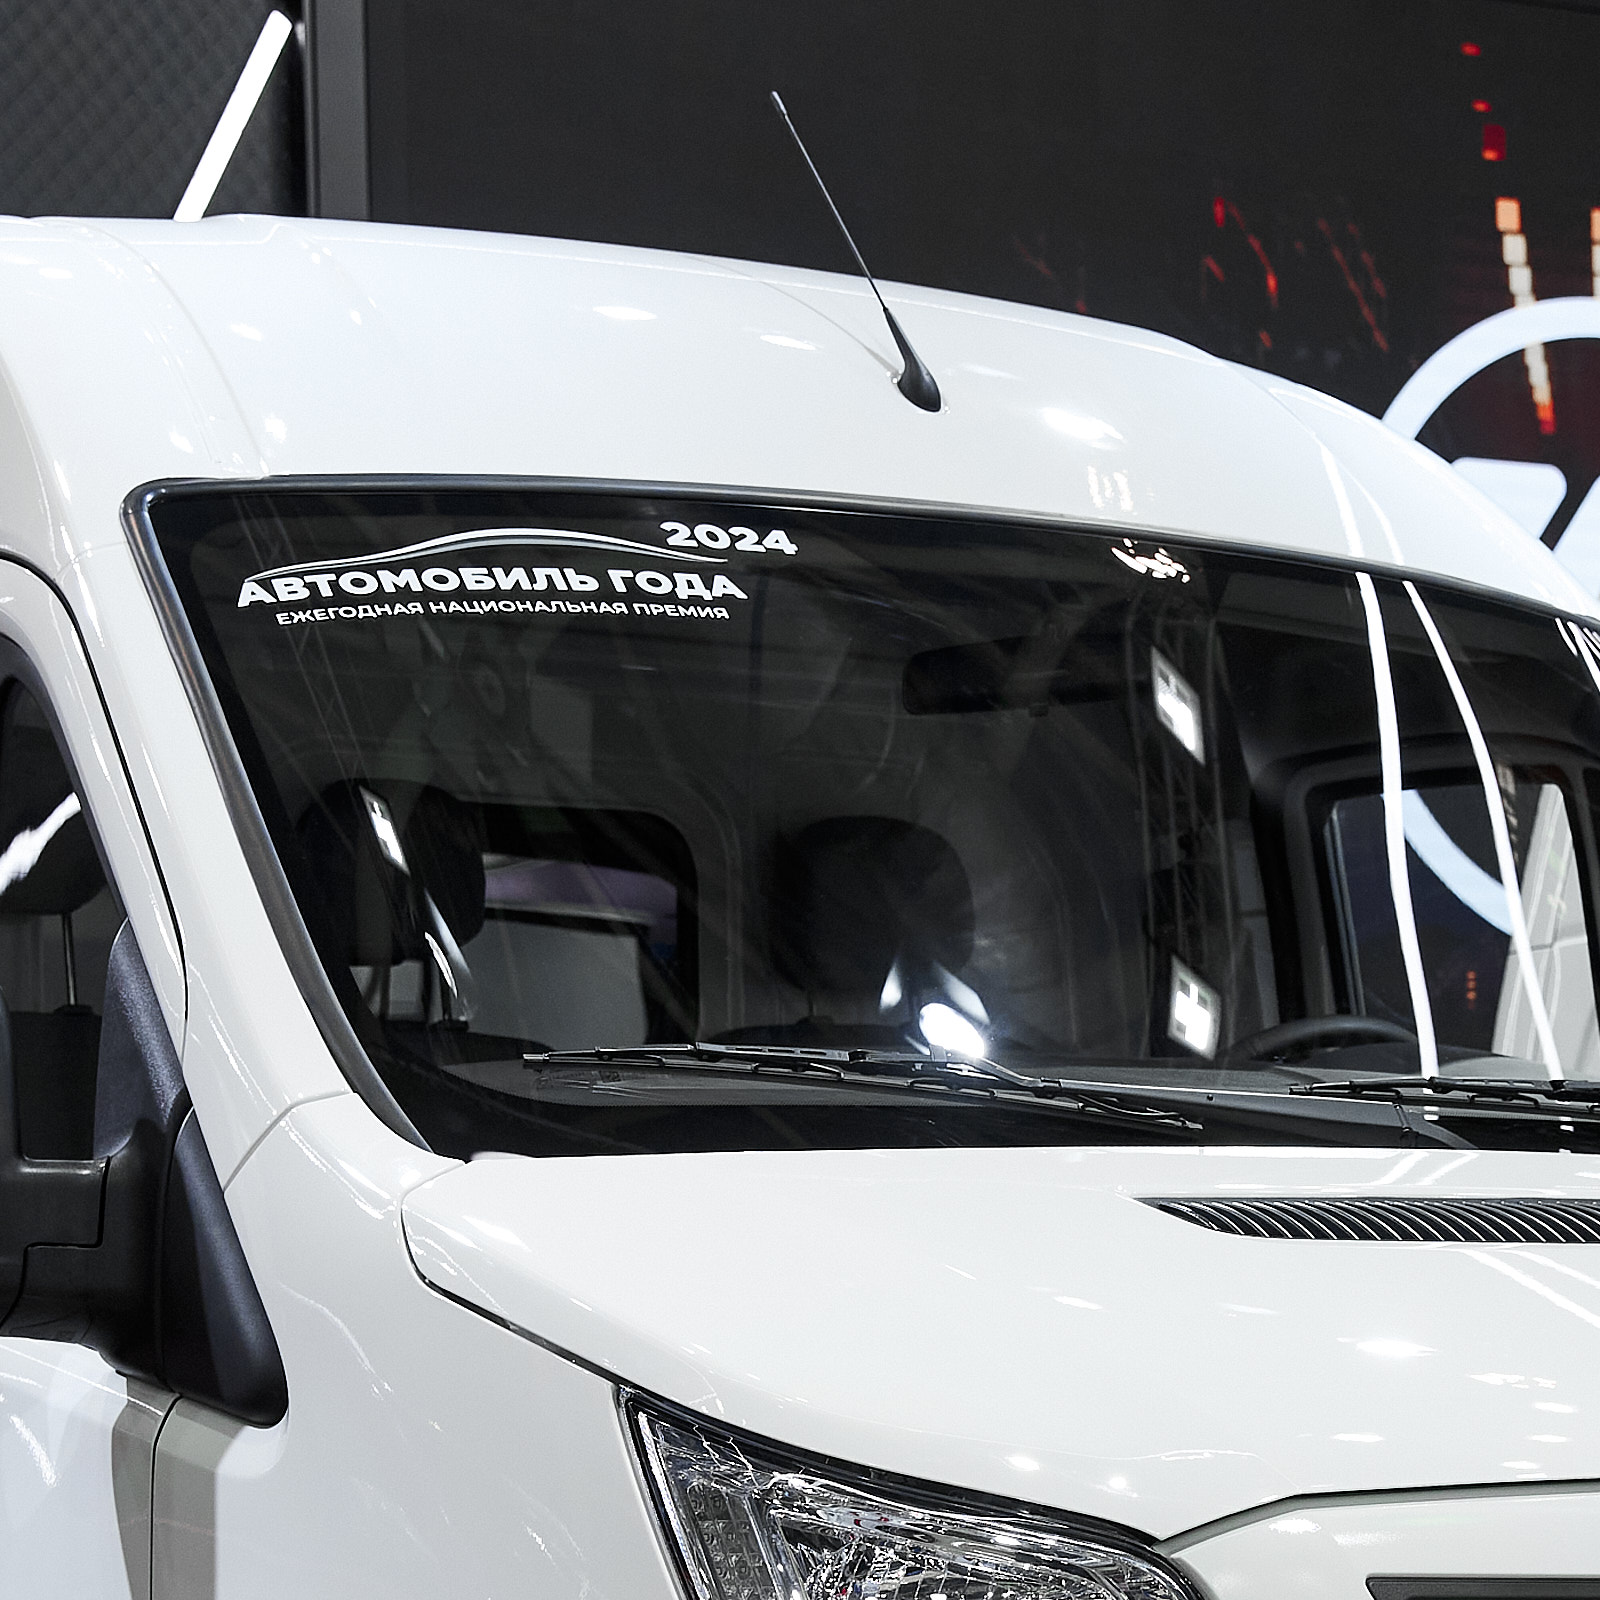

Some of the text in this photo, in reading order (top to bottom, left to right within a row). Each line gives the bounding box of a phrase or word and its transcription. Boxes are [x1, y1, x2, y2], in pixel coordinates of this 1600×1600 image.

[658, 519, 799, 557] 2024
[237, 566, 748, 608] АВТОМОБИЛЬ ГОДА
[276, 599, 729, 626] ЕЖЕГОДНАЯ НАЦИОНАЛЬНАЯ ПРЕМИЯ
